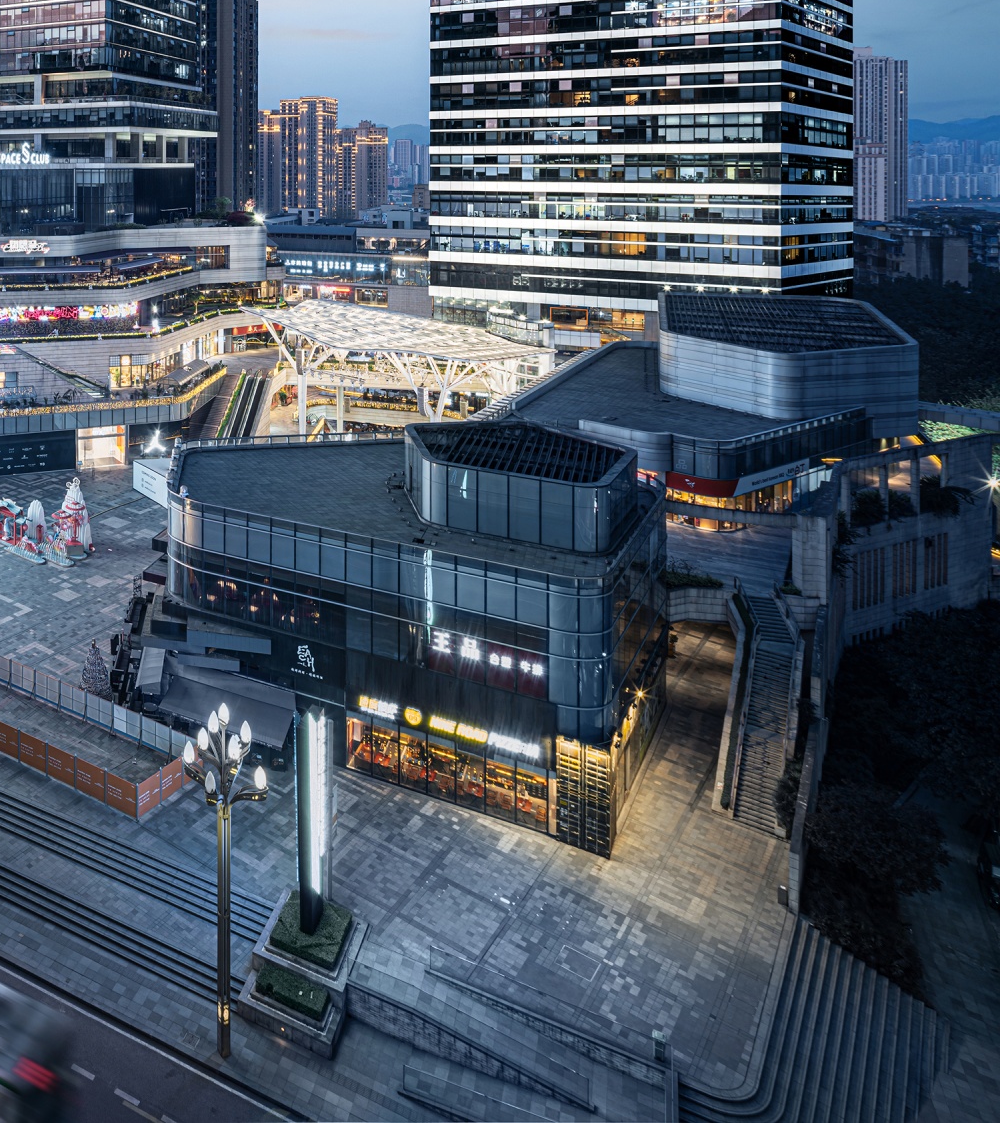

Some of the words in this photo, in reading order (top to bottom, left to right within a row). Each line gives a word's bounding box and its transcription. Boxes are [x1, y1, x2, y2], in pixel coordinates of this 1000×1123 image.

[31, 152, 51, 165] CLUB
[432, 631, 480, 661] 王品
[456, 722, 489, 744] ROAD
